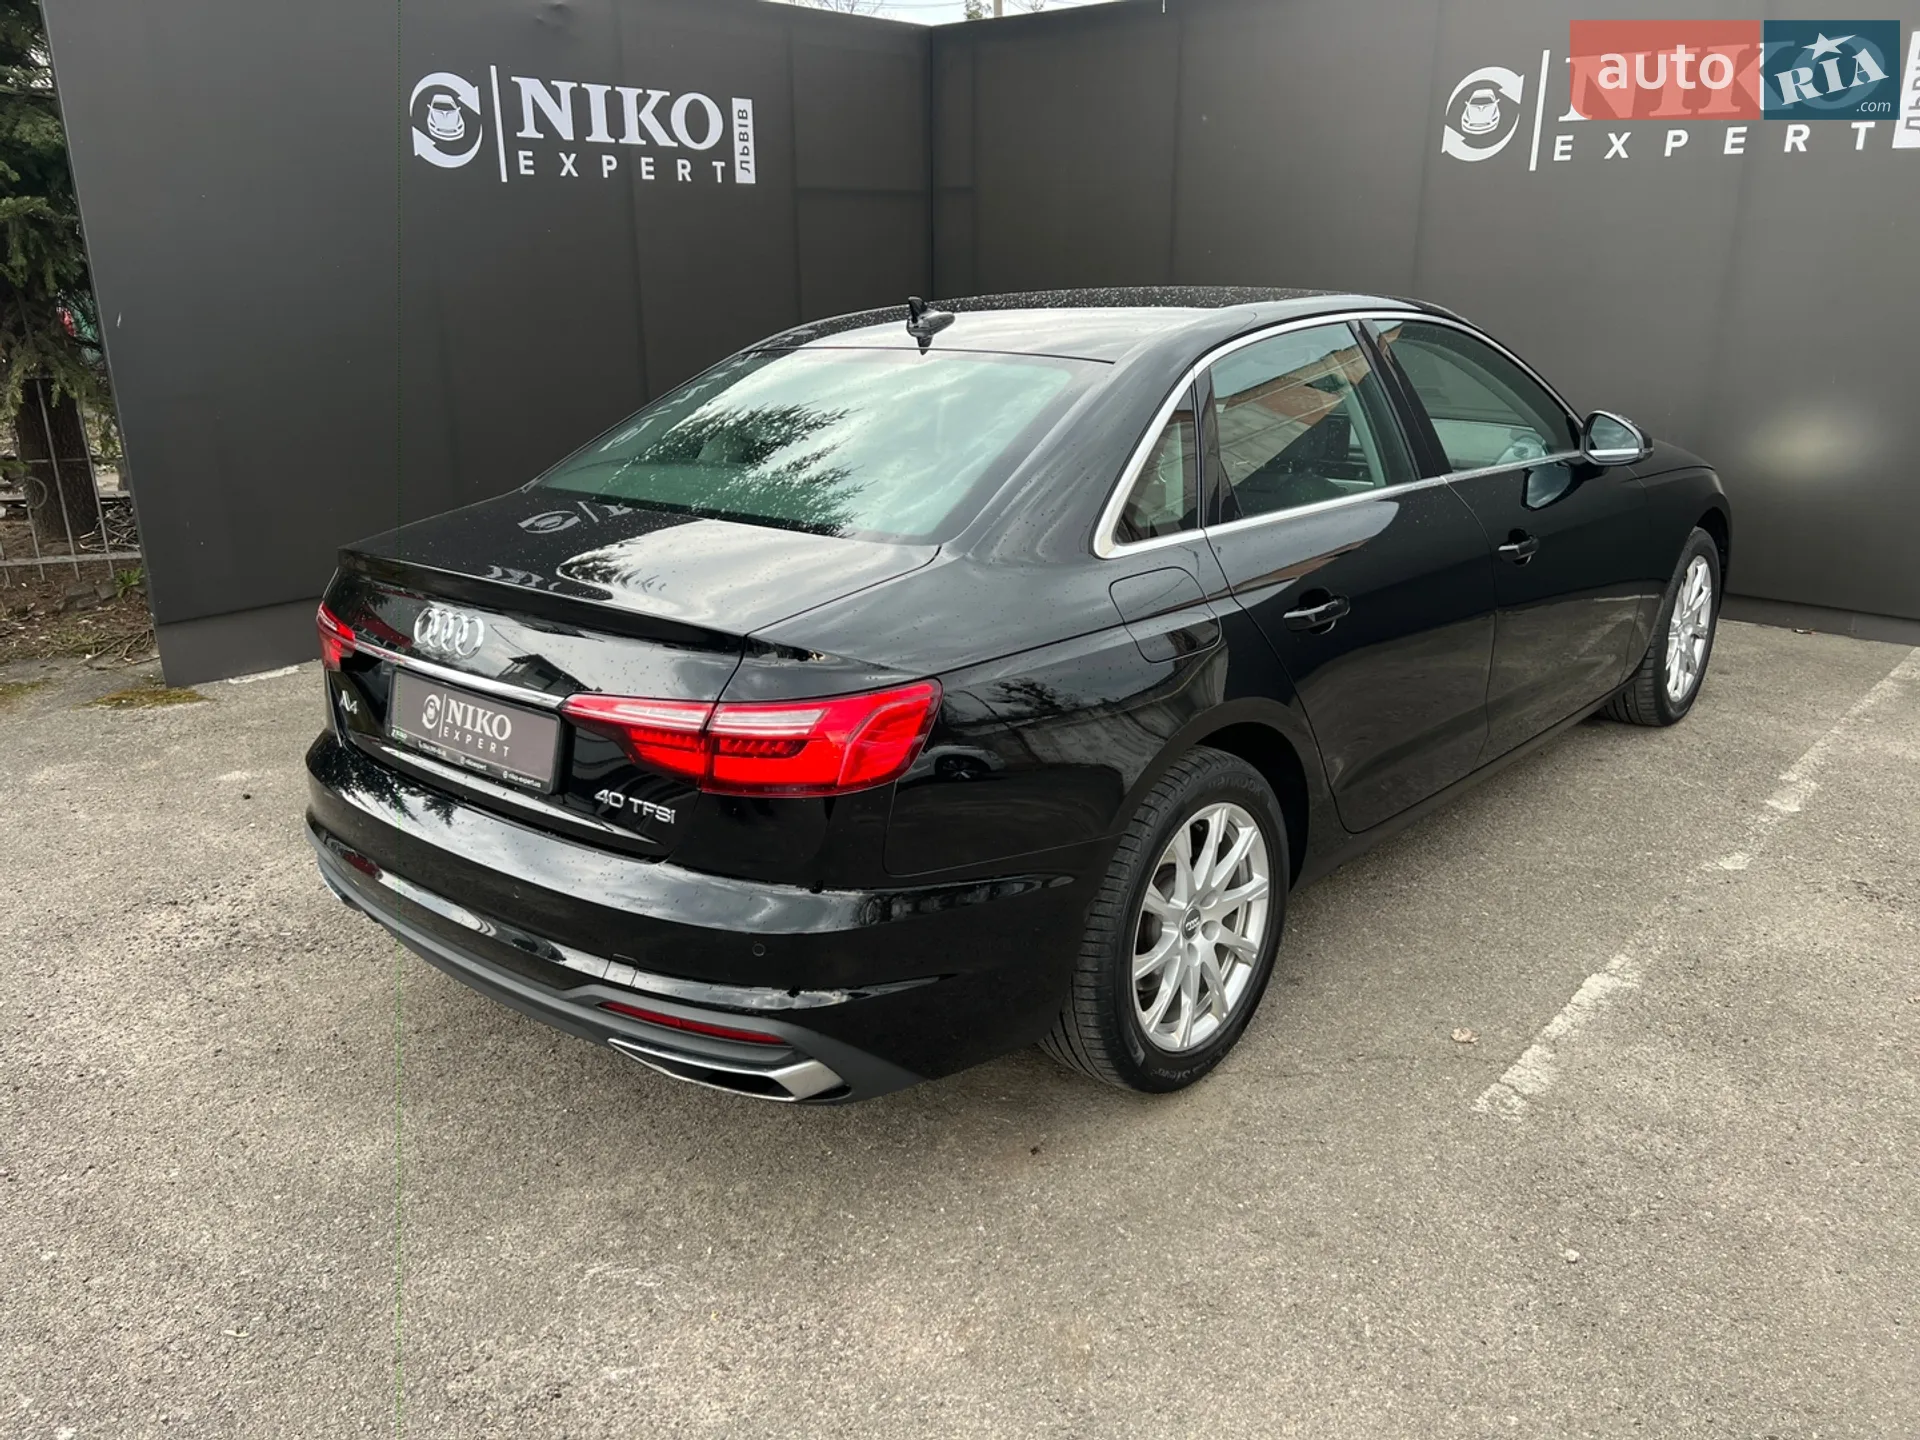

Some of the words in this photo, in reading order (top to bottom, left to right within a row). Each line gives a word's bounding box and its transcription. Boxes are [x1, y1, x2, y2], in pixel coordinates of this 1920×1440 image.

[511, 76, 724, 150] NIKO
[737, 108, 751, 174] ЛЬВІВ
[1553, 122, 1875, 162] EXPERT
[517, 150, 725, 184] EXPERT
[338, 690, 358, 715] A4
[445, 698, 512, 741] NIKO
[443, 726, 510, 757] EXPERT
[594, 789, 625, 809] 40
